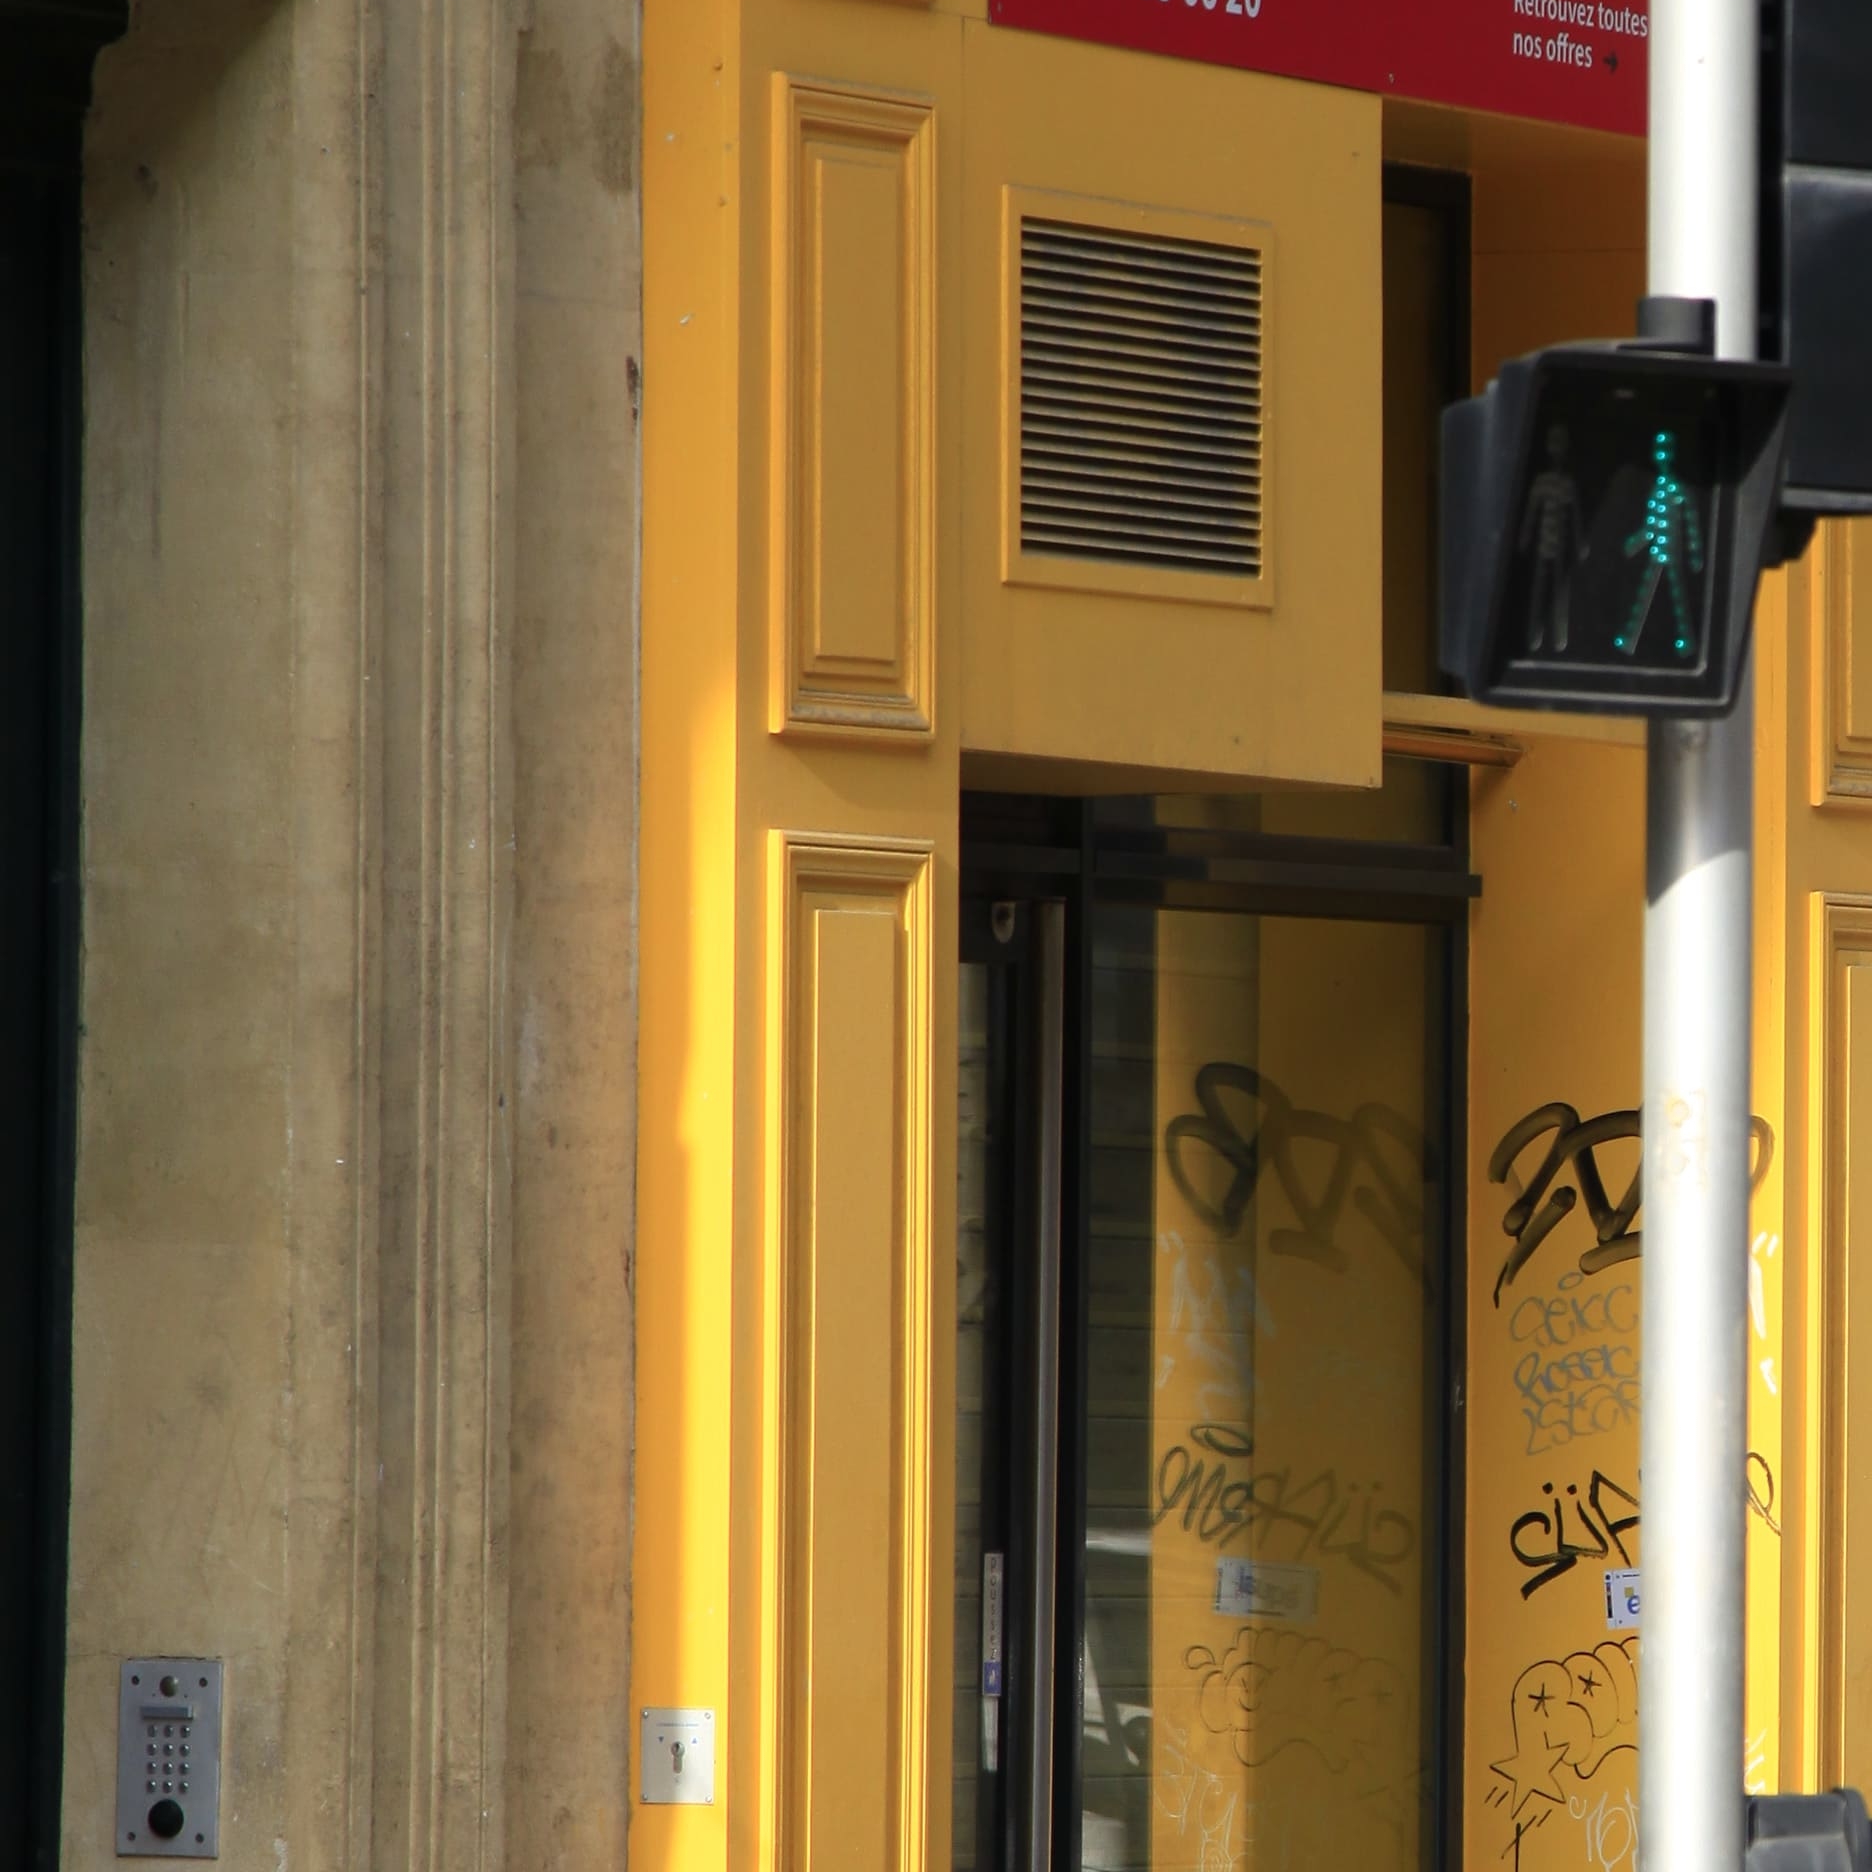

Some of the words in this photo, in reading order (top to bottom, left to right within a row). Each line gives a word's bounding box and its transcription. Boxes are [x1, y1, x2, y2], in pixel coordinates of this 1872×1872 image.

[1598, 3, 1650, 39] toutes
[1513, 30, 1544, 62] nos
[1546, 31, 1594, 70] offres
